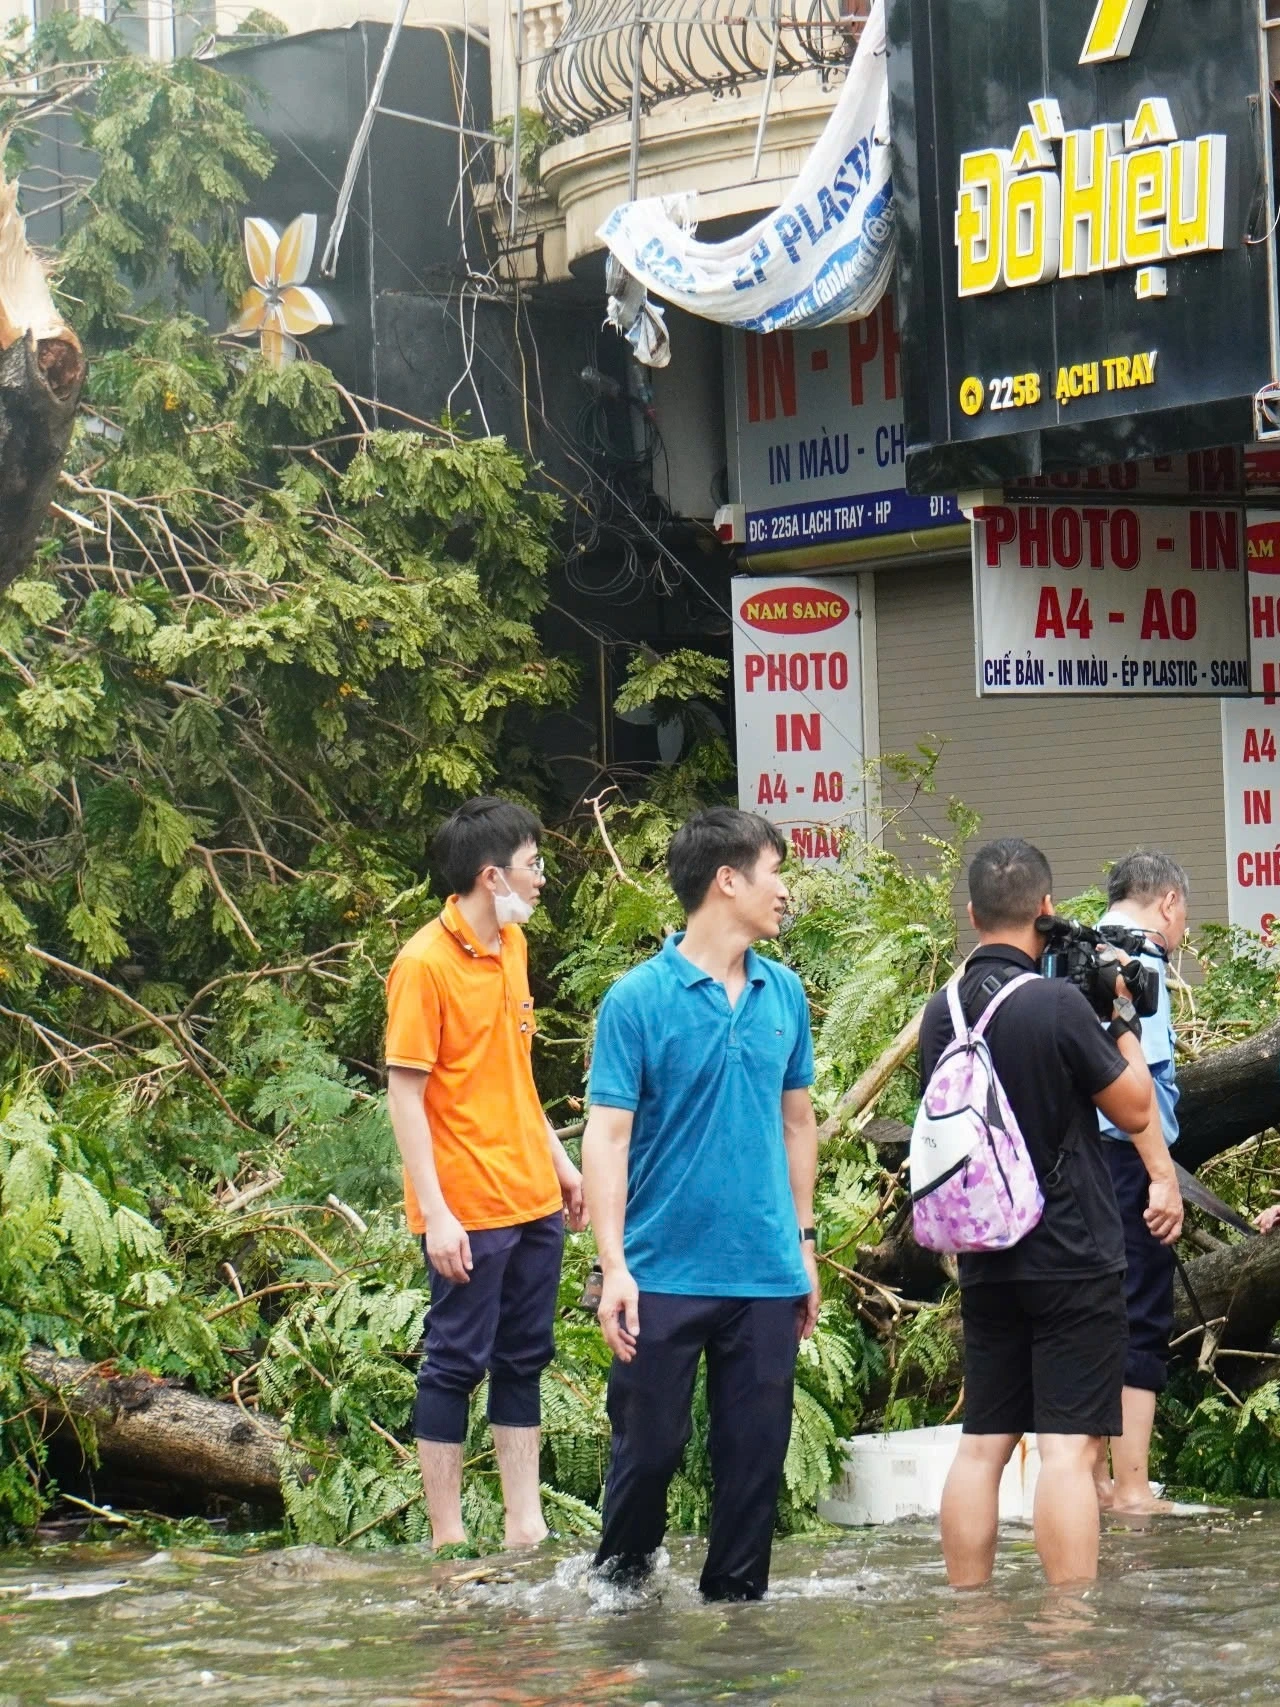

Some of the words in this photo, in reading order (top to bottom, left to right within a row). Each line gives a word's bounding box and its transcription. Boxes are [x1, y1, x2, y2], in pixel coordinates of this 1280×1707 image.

[989, 373, 1041, 410] 225B
[1102, 350, 1158, 391] TRAY
[768, 443, 791, 485] IN
[800, 427, 849, 481] MÀU
[876, 423, 906, 467] CH
[749, 520, 768, 542] ĐC:
[772, 515, 799, 539] 225A
[802, 512, 832, 539] LẠCH
[834, 504, 865, 530] TRAY
[875, 501, 892, 525] HP
[973, 506, 1140, 570] PHOTO
[1190, 510, 1240, 571] IN
[1247, 540, 1274, 558] AM
[746, 602, 788, 620] NAM
[792, 601, 842, 619] SANG
[1034, 586, 1093, 639] A4
[745, 652, 848, 692] PHOTO
[984, 651, 1012, 687] CHẾ
[1015, 650, 1044, 687] BẢN
[1058, 659, 1073, 686] IN
[1077, 654, 1108, 687] MÀU
[1121, 654, 1139, 687] ÉP
[1143, 660, 1198, 688] PLASTIC
[1210, 660, 1250, 688] SCAN
[775, 713, 822, 752] IN
[1243, 728, 1276, 762] A4
[757, 773, 788, 804] A4
[1244, 790, 1272, 825] IN
